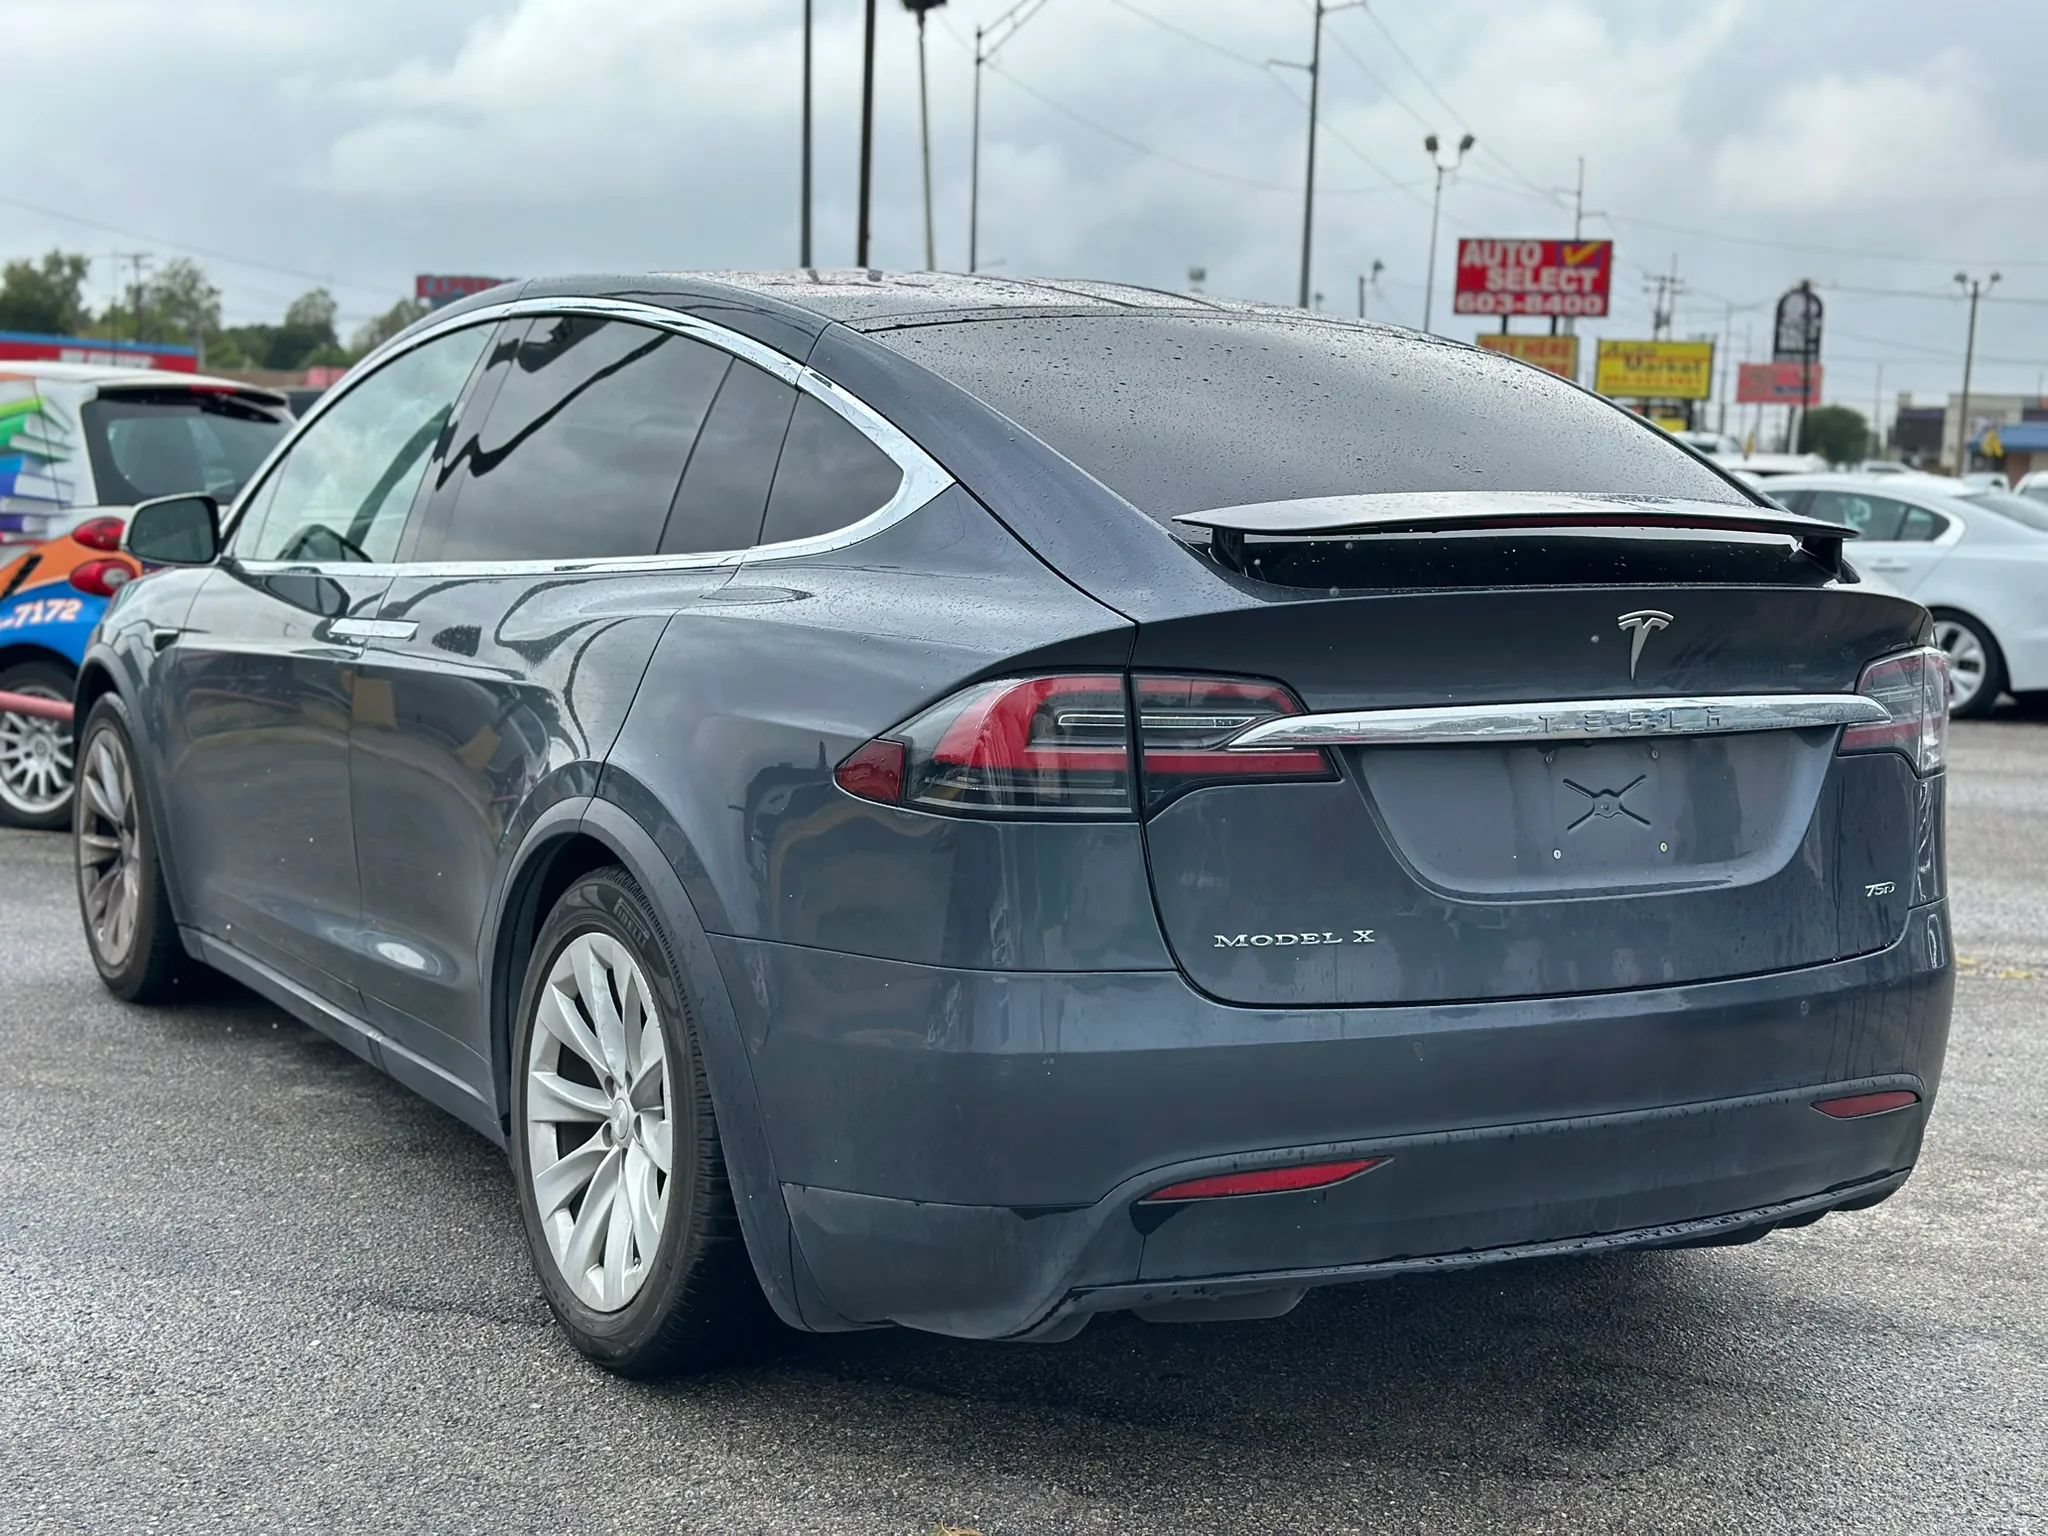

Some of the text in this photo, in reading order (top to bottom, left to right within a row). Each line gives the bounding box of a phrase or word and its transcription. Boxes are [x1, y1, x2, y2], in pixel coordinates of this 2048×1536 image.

[1460, 240, 1543, 268] AUTO
[1485, 266, 1598, 293] SELECT
[1538, 706, 1721, 734] TESLA
[1864, 881, 1897, 897] 75D
[1213, 929, 1376, 948] MODEL X
